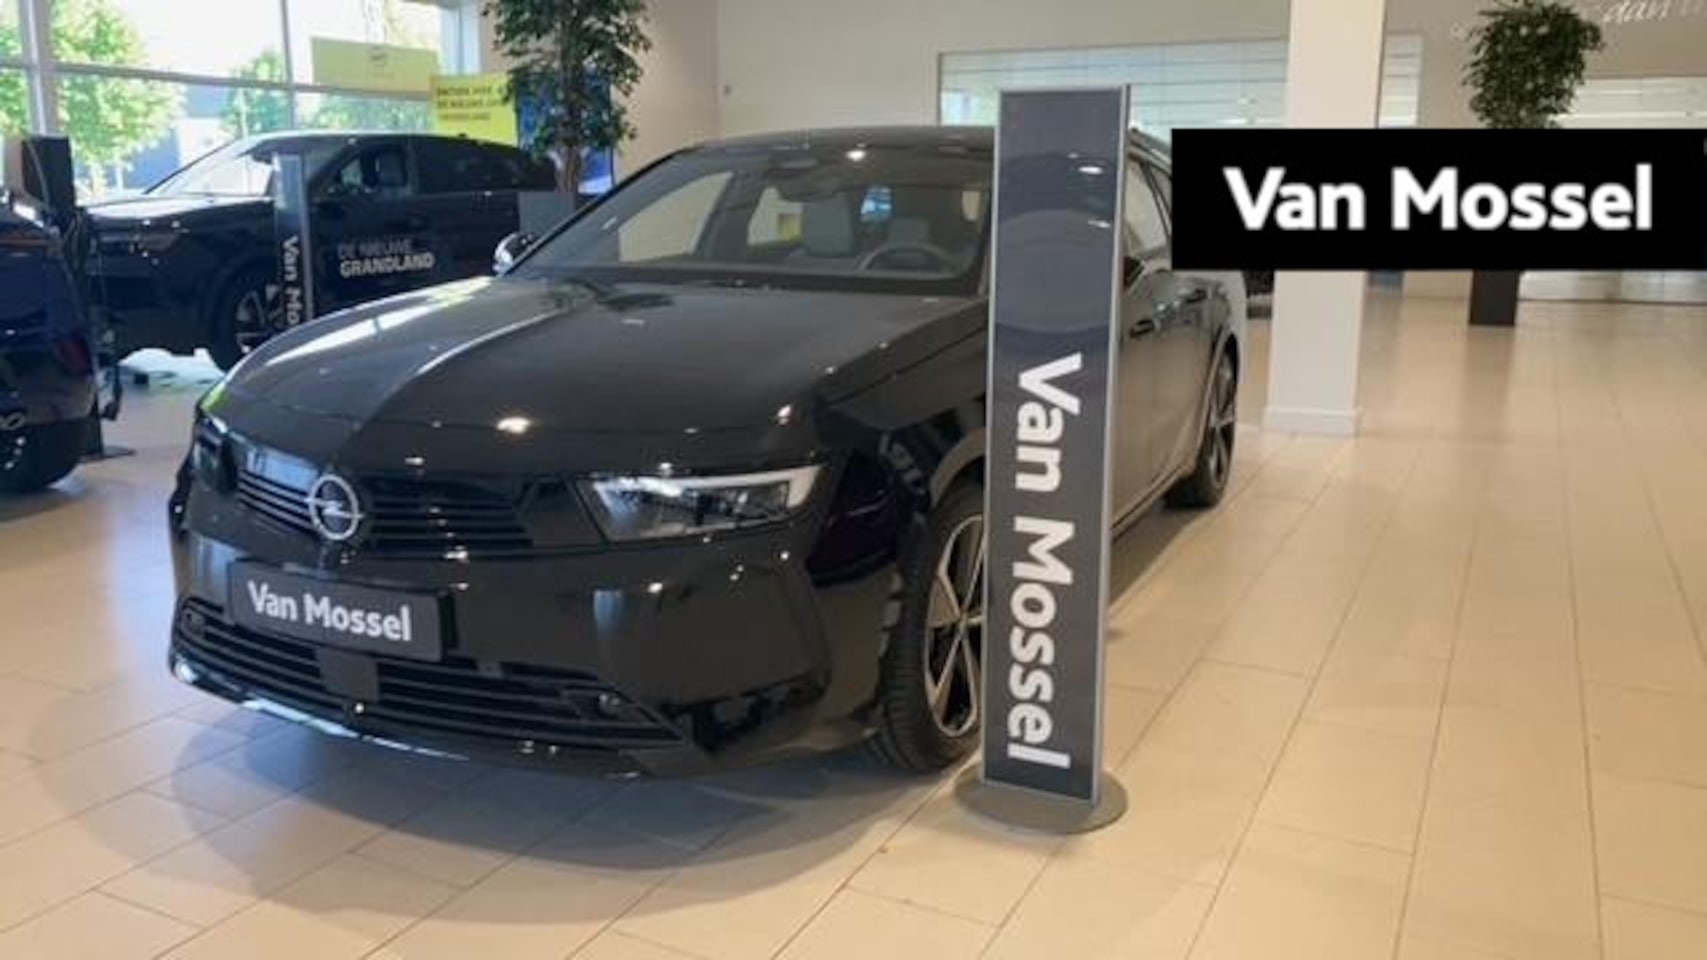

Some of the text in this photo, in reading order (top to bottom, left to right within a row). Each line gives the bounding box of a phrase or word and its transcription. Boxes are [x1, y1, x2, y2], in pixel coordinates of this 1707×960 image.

[283, 235, 299, 281] Van
[340, 252, 435, 278] GRANDLAND
[1007, 353, 1083, 769] Van Mossel
[247, 579, 412, 642] Van Mossel
